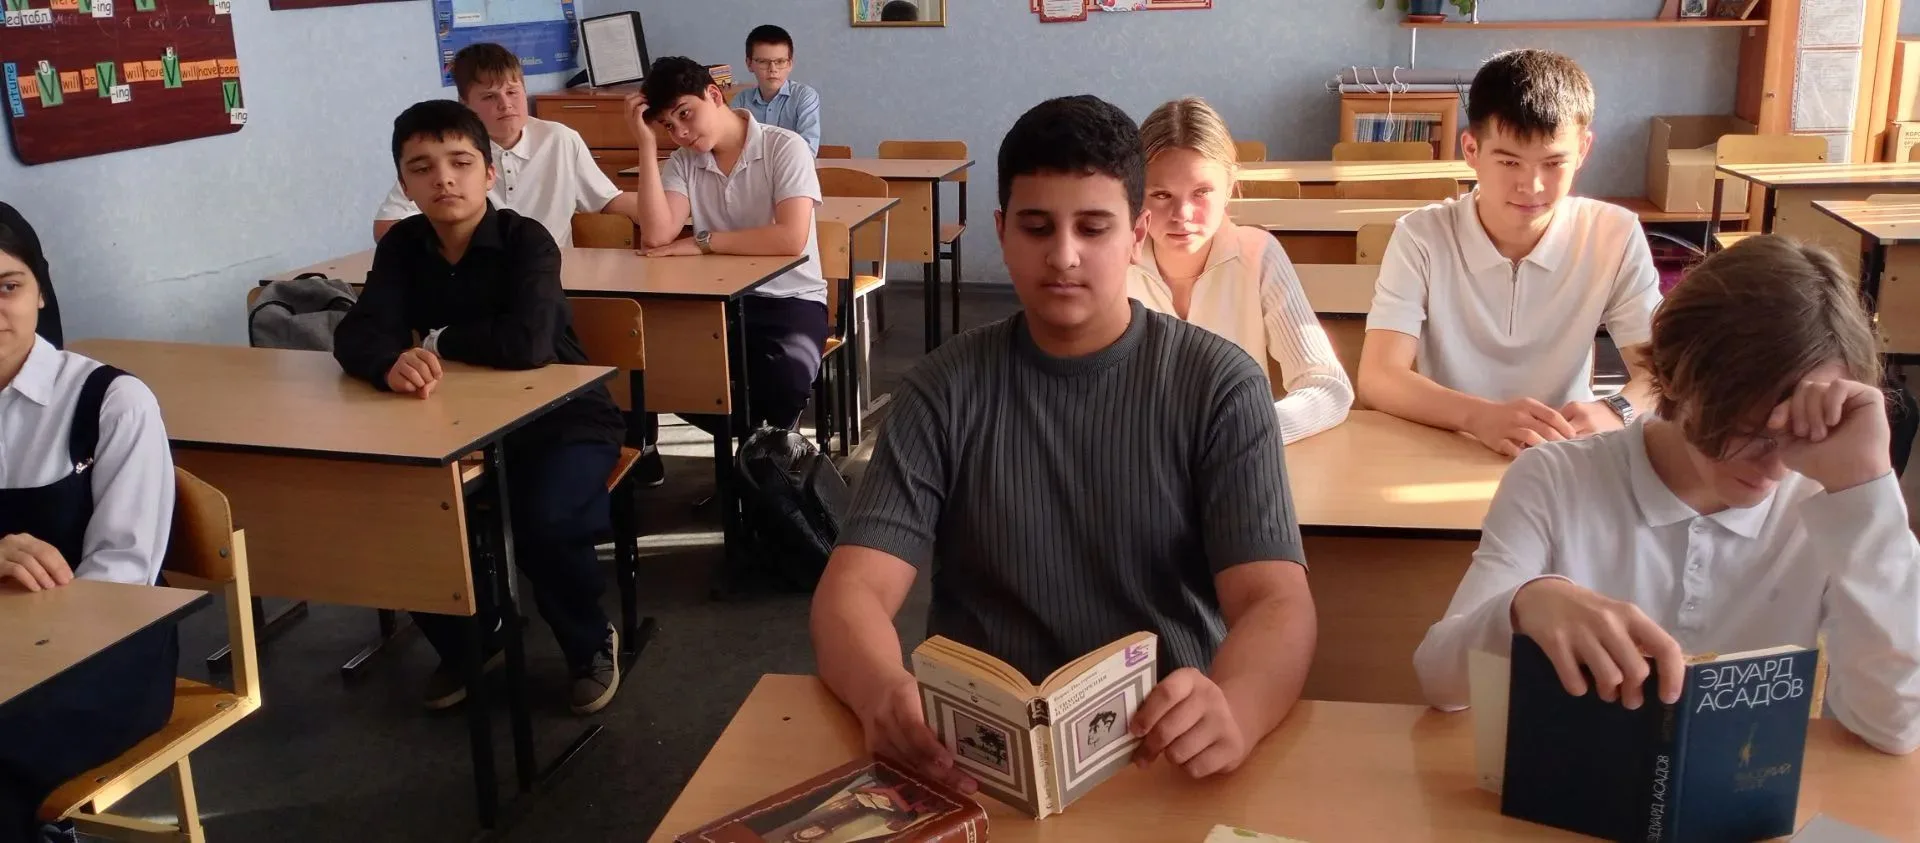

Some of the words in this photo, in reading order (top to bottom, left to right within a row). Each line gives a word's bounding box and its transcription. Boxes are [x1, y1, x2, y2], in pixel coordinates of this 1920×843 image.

[62, 76, 79, 91] will
[84, 75, 96, 86] be
[125, 65, 143, 80] will
[145, 64, 164, 77] have
[1698, 657, 1794, 691] ЭДУАРД
[1696, 678, 1804, 714] АСАДОВ
[1652, 755, 1670, 801] АСАДОВ
